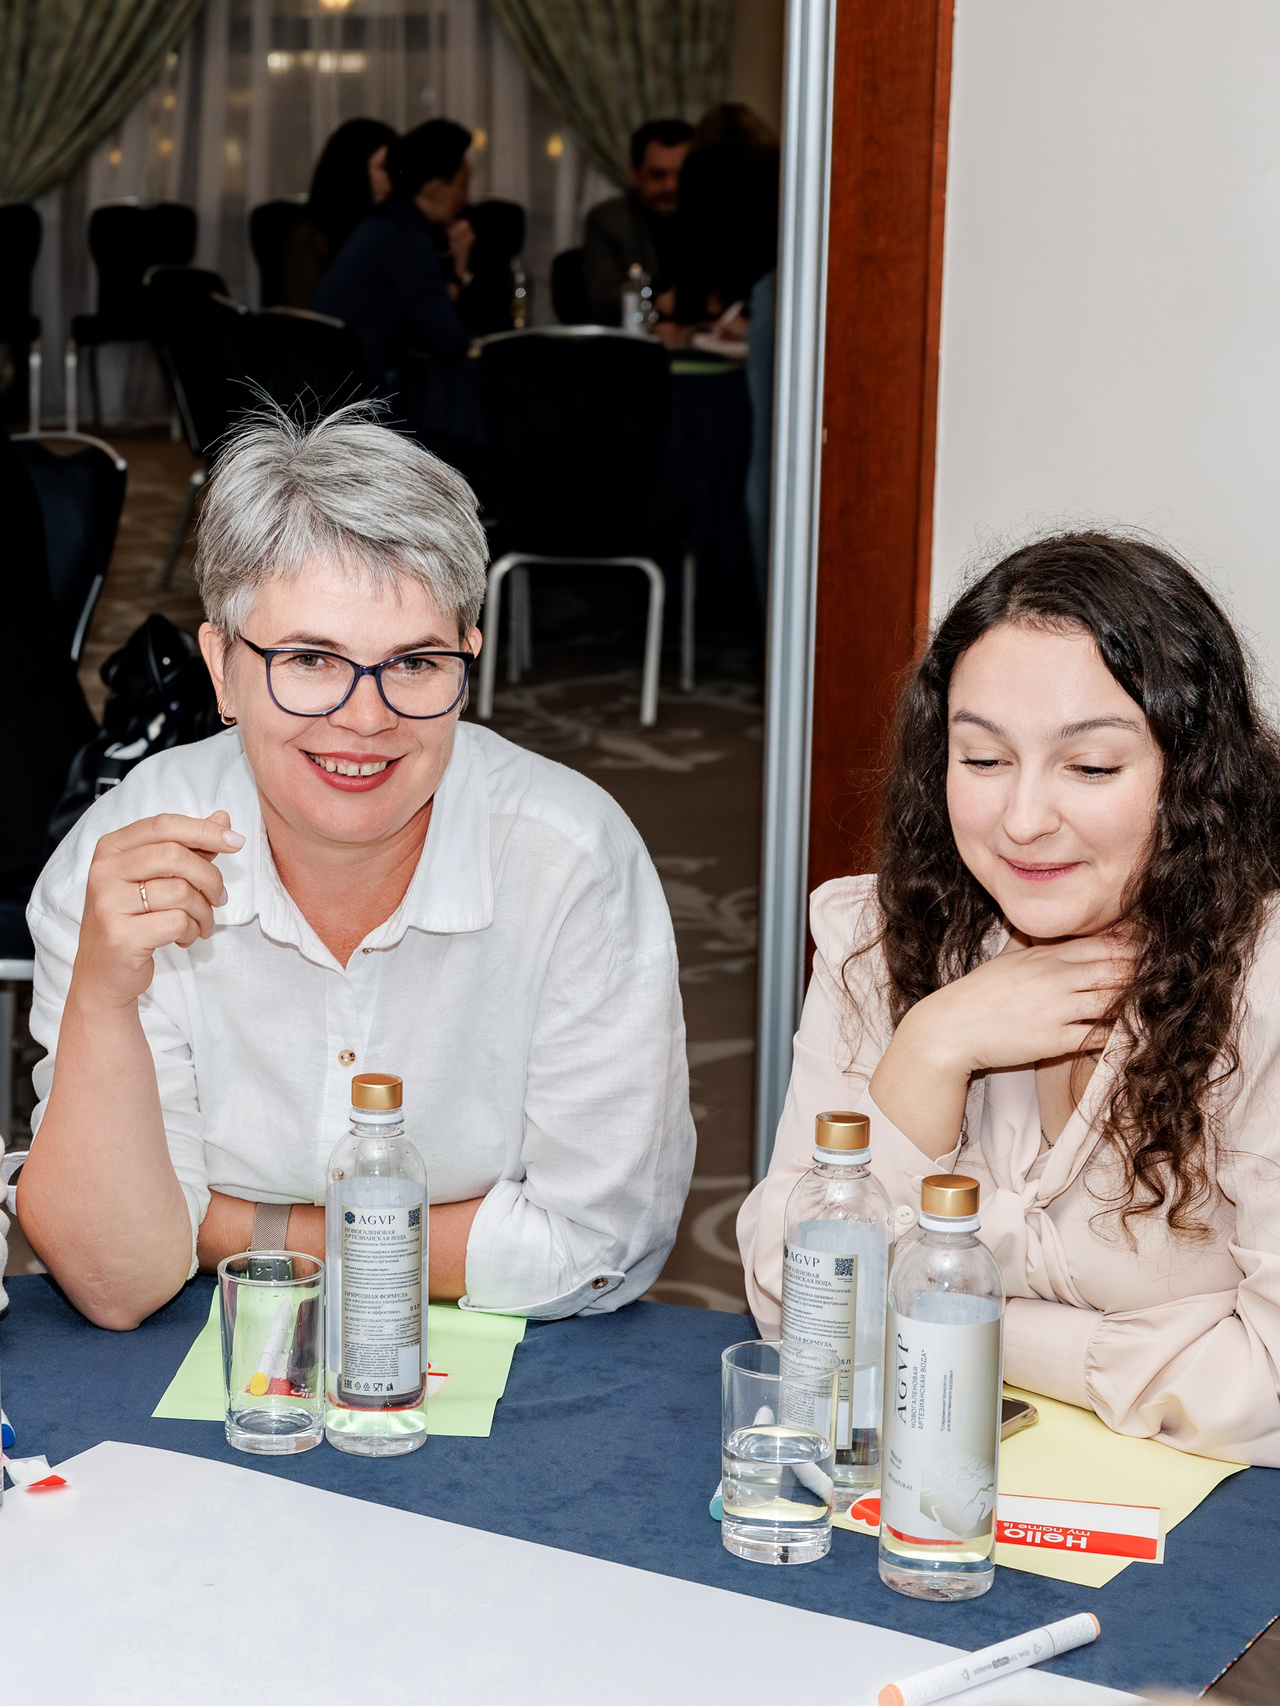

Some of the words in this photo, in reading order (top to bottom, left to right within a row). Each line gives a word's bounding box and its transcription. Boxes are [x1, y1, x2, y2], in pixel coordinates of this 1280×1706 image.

[359, 1214, 396, 1225] AGVP
[790, 1251, 820, 1267] AGVP
[897, 1332, 910, 1425] AGVP
[910, 1366, 918, 1429] НОВОГАЛЕНОВАЯ
[918, 1374, 926, 1430] АРТЕЗИАНСКАЯ
[1018, 1523, 1062, 1533] name
[1067, 1528, 1090, 1536] my
[1003, 1528, 1087, 1549] Hello
